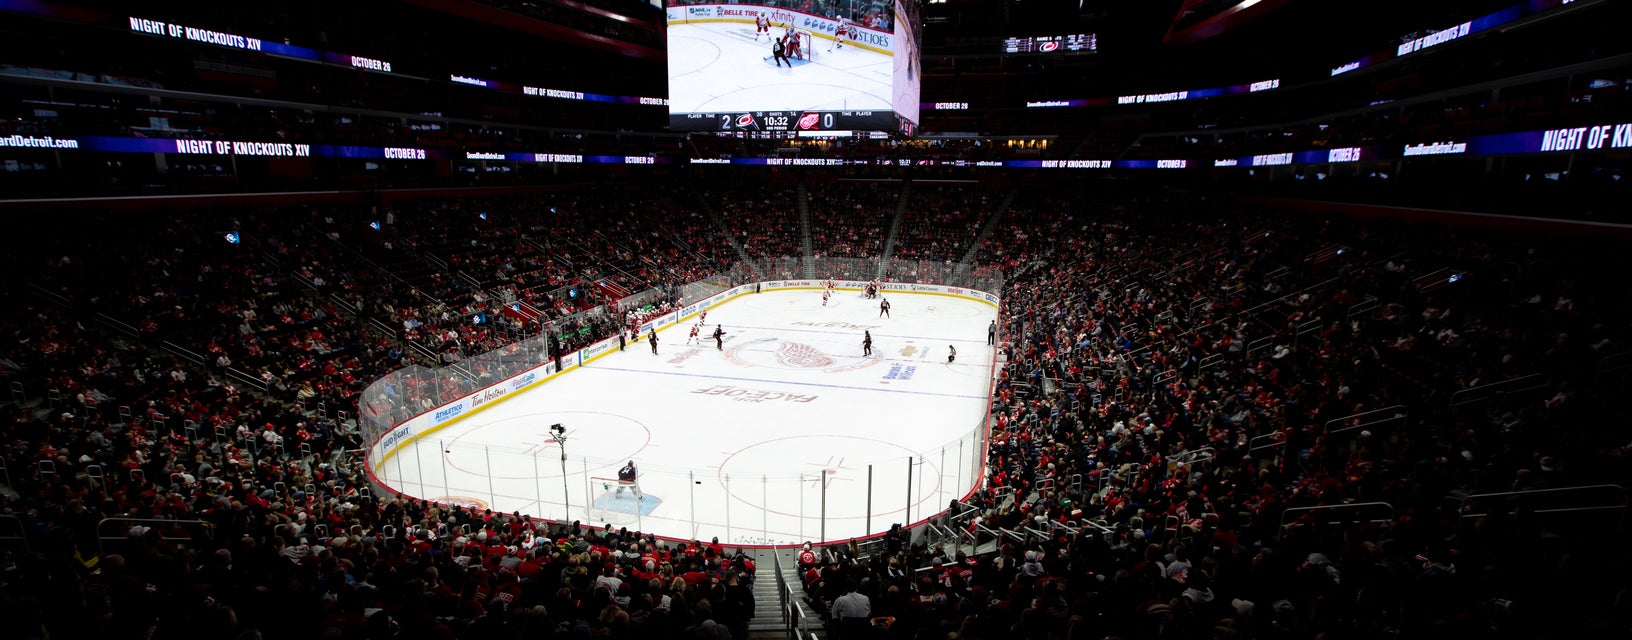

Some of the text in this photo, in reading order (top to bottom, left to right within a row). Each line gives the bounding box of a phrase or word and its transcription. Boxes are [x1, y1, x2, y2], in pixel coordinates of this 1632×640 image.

[771, 10, 795, 22] xfinity
[130, 16, 261, 51] NIGHT OF KNOCKOUTS XIV
[352, 56, 391, 72] OCTOBER 26
[1250, 79, 1279, 92] OCTOBER 26
[523, 86, 538, 96] NIGHT
[538, 87, 546, 97] OF
[546, 88, 576, 99] KNOCKOUTS
[1118, 95, 1134, 104] NIGHT
[1136, 94, 1144, 104] OF
[1146, 92, 1178, 103] KNOCKOUTS
[640, 96, 662, 105] OCTOBER
[935, 102, 960, 110] OCTOBER
[722, 115, 730, 129] 2
[764, 116, 788, 126] 10:32
[824, 114, 833, 128] 0
[0, 135, 78, 149] ardDetroit.com
[1541, 127, 1584, 152] NIGHT
[1587, 126, 1611, 149] OF
[176, 139, 310, 157] NIGHT OF KNOCKOUTS XIV
[384, 147, 425, 159] OCTOBER 26
[1329, 147, 1361, 162] OCTOBER 26
[1404, 141, 1466, 156] SoundBoardDetroit.com
[466, 152, 505, 160] SoundBoardDetroit.com
[554, 154, 576, 163] KNOCKOUTS
[625, 156, 645, 164] OCTOBER
[793, 158, 825, 166] KNOCKOUTS
[1042, 160, 1058, 168] NIGHT
[1059, 160, 1067, 168] OF
[1067, 160, 1101, 168] KNOCKOUTS
[1157, 160, 1186, 168] OCTOBER 26
[471, 388, 506, 408] Tim Hortons
[435, 404, 463, 420] ATHLETICO
